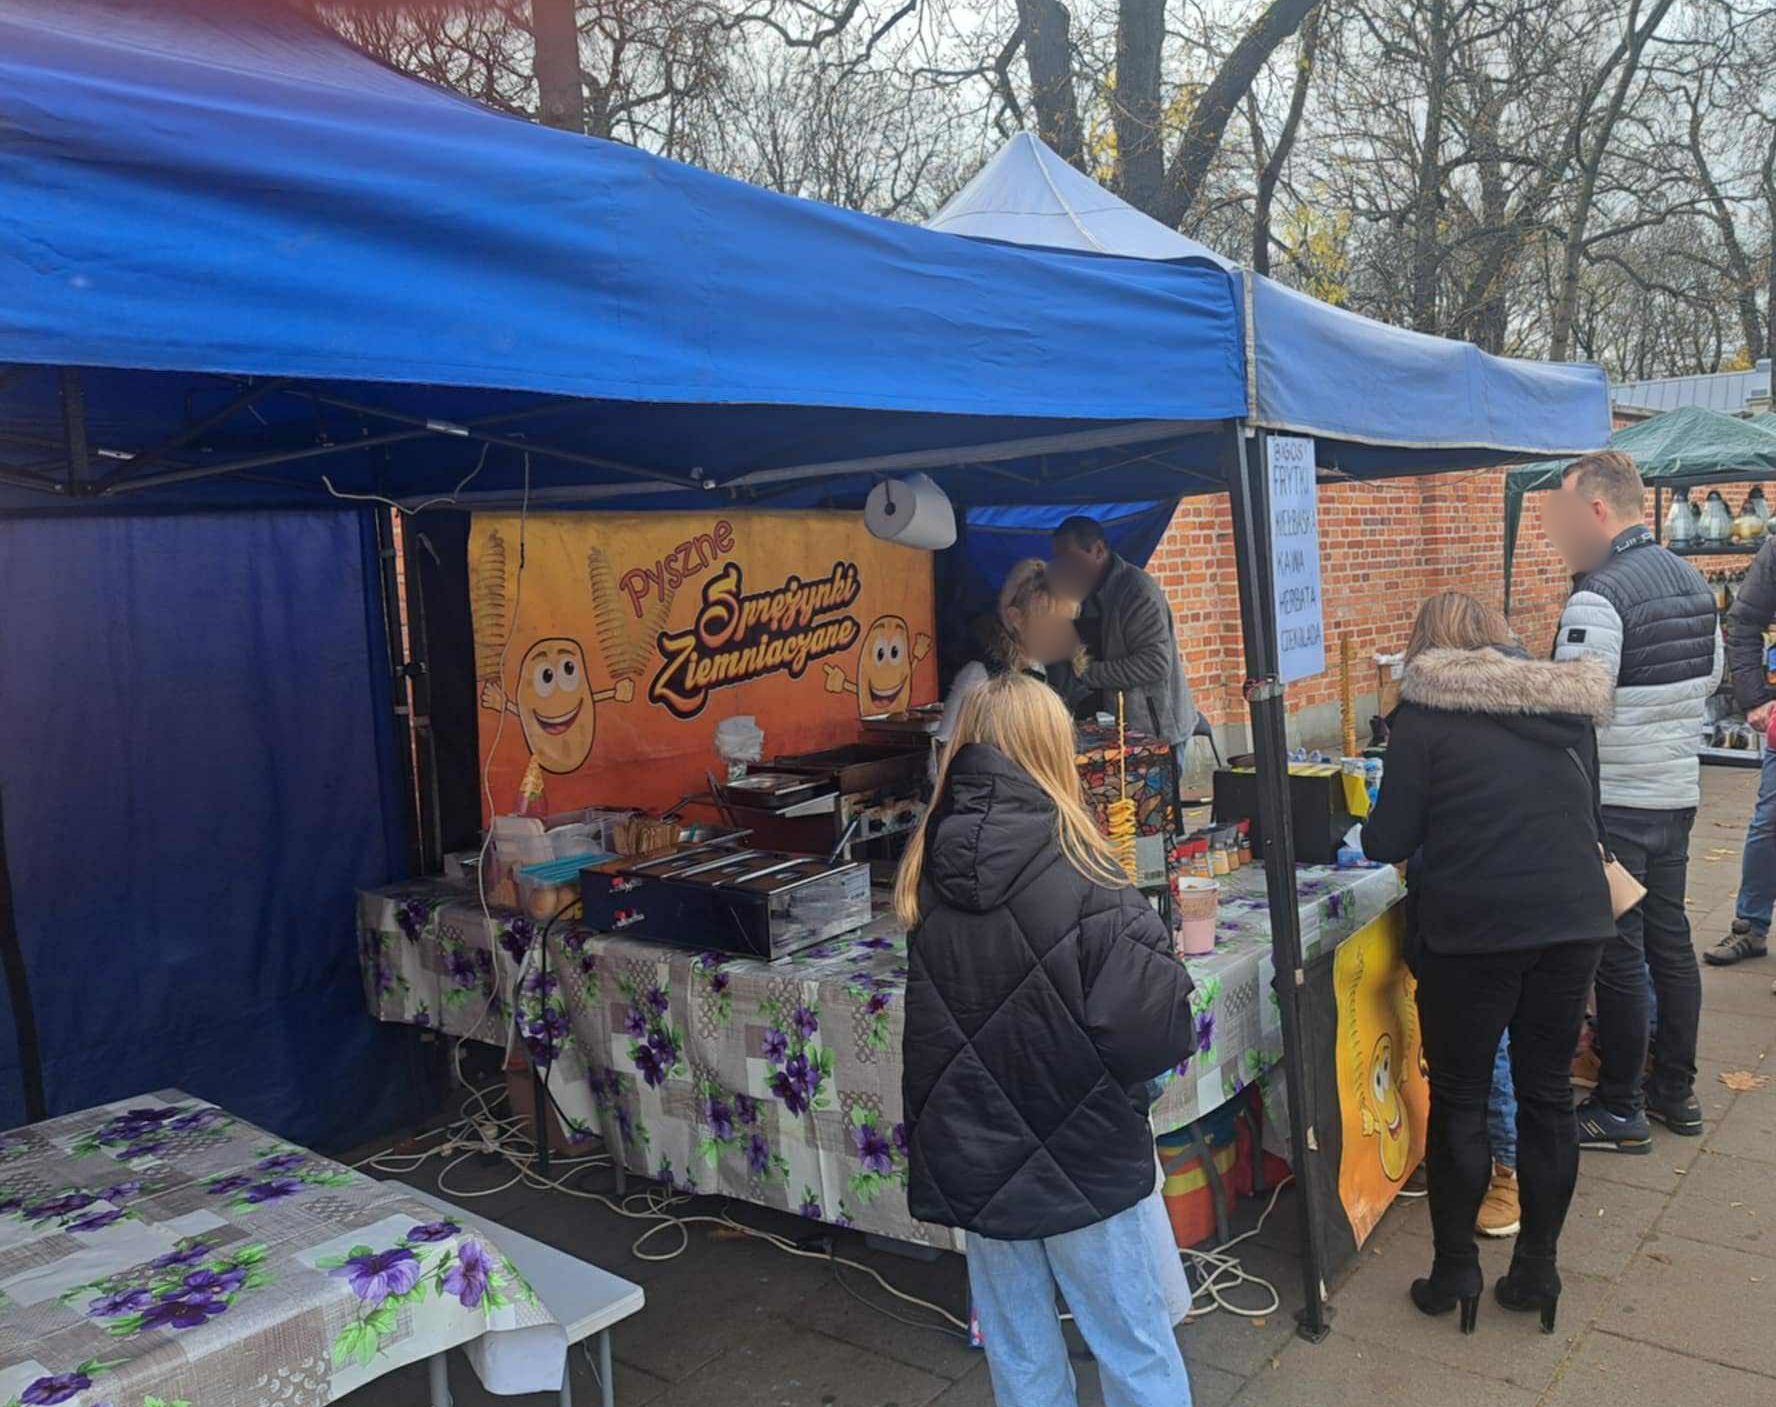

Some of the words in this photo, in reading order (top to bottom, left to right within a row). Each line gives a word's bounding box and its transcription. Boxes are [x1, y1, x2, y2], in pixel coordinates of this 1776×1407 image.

[1277, 549, 1305, 576] KAWA
[701, 562, 859, 648] Sprężynki
[1279, 585, 1317, 616] HERBATA
[651, 617, 858, 715] Ziemniaczane
